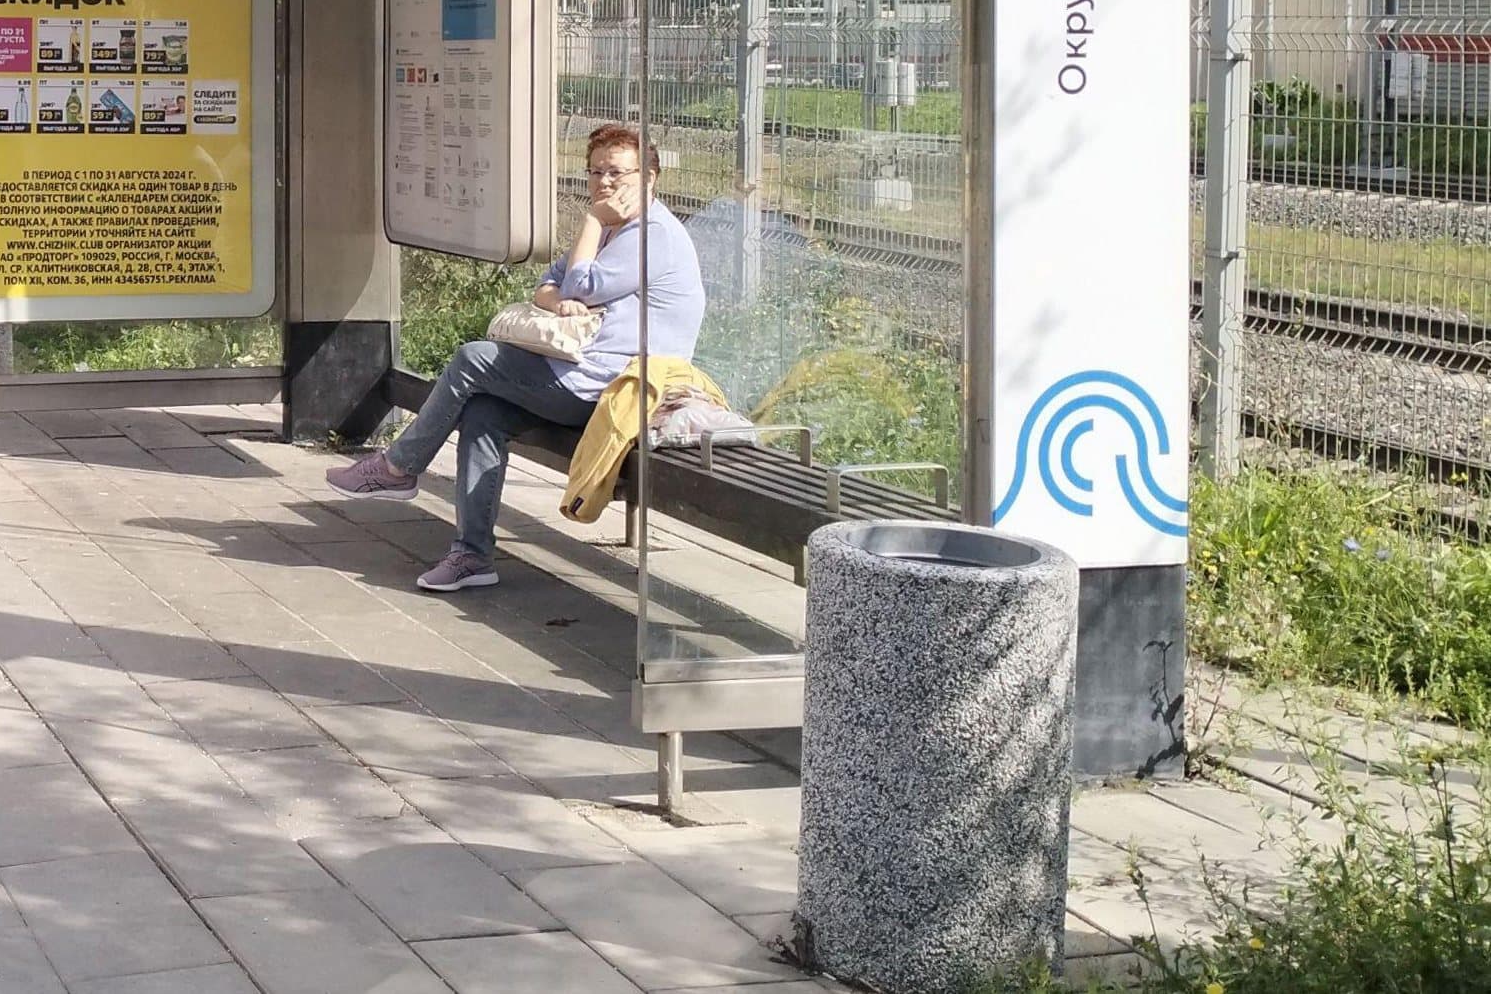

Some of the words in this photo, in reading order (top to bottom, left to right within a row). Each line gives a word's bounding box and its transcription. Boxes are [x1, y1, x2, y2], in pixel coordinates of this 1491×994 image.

[194, 90, 237, 99] СЛЕДИТЕ
[23, 170, 30, 181] В
[31, 170, 72, 181] ПЕРИОД
[74, 170, 81, 181] С
[82, 170, 87, 181] 1
[89, 170, 104, 181] ПО
[105, 170, 116, 181] 31
[118, 170, 161, 181] АВГУСТА
[162, 170, 186, 181] 2024
[188, 170, 197, 181] Г.
[79, 182, 121, 192] СКИДКА
[122, 182, 136, 192] НА
[138, 182, 167, 192] ОДИН
[169, 182, 202, 192] ТОВАР
[203, 182, 209, 192] В
[211, 182, 238, 192] ДЕНЬ
[0, 194, 7, 204] В
[9, 194, 85, 204] СООТВЕТСТВИИ
[87, 194, 93, 204] С
[95, 194, 169, 204] «КАЛЕНДАРЕМ
[43, 206, 119, 215] ИНФОРМАЦИЮ
[121, 206, 129, 215] О
[131, 206, 176, 215] ТОВАРАХ
[178, 206, 213, 215] АКЦИИ
[215, 206, 222, 215] И
[51, 217, 59, 227] А
[60, 217, 94, 227] ТАКЖЕ
[96, 217, 149, 227] ПРАВИЛАХ
[151, 217, 220, 227] ПРОВЕДЕНИЯ,
[22, 228, 87, 238] ТЕРРИТОРИИ
[89, 228, 146, 238] УТОЧНЯЙТЕ
[148, 228, 163, 238] НА
[164, 228, 196, 238] САЙТЕ
[6, 240, 104, 250] WWW.CHIZHIK.CLUB
[105, 240, 175, 250] ОРГАНИЗАТОР
[176, 240, 212, 250] АКЦИИ
[0, 252, 14, 262] АО
[16, 252, 79, 262] «ПРОДТОРГ»
[82, 252, 120, 262] 109029,
[121, 252, 163, 262] РОССИЯ,
[175, 252, 220, 262] МОСКВА,
[10, 264, 25, 274] СР.
[27, 264, 123, 274] КАЛИТНИКОВСКАЯ,
[137, 264, 153, 274] 28,
[154, 264, 175, 274] СТР.
[177, 264, 187, 274] 4,
[188, 264, 216, 274] ЭТАЖ
[3, 275, 27, 285] ПОМ
[47, 275, 72, 285] КОМ.
[74, 275, 89, 285] 36,
[91, 275, 113, 285] ИНН
